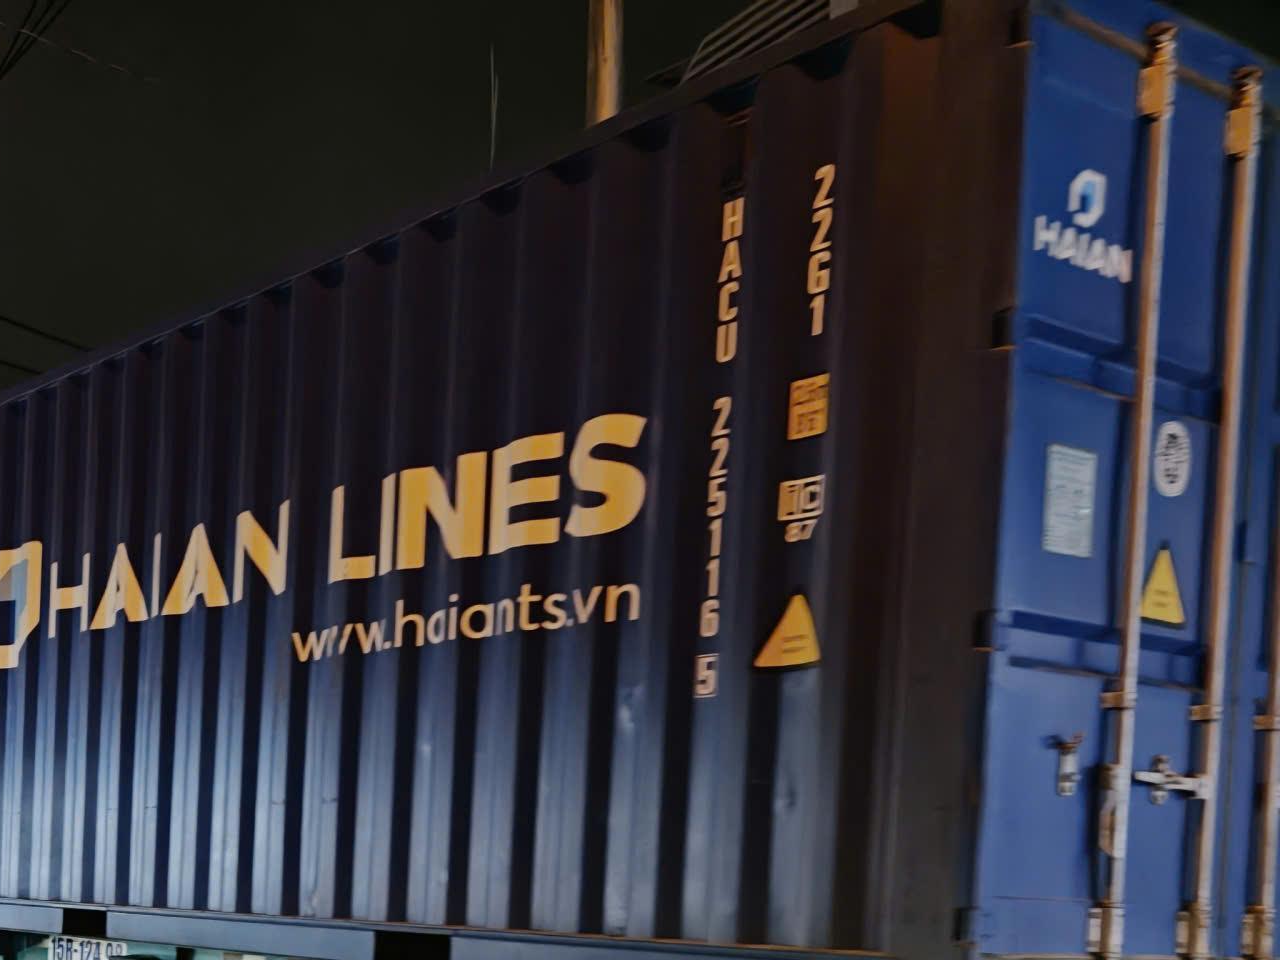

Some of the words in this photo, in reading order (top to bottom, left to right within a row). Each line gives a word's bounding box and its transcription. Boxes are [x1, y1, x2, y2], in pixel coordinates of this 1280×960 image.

[715, 196, 746, 364] HACU
[1034, 215, 1133, 284] HAIAN
[48, 500, 291, 638] HAIAN
[328, 414, 647, 584] LINES
[698, 395, 732, 638] 225116
[291, 582, 641, 663] www.haiants.vn
